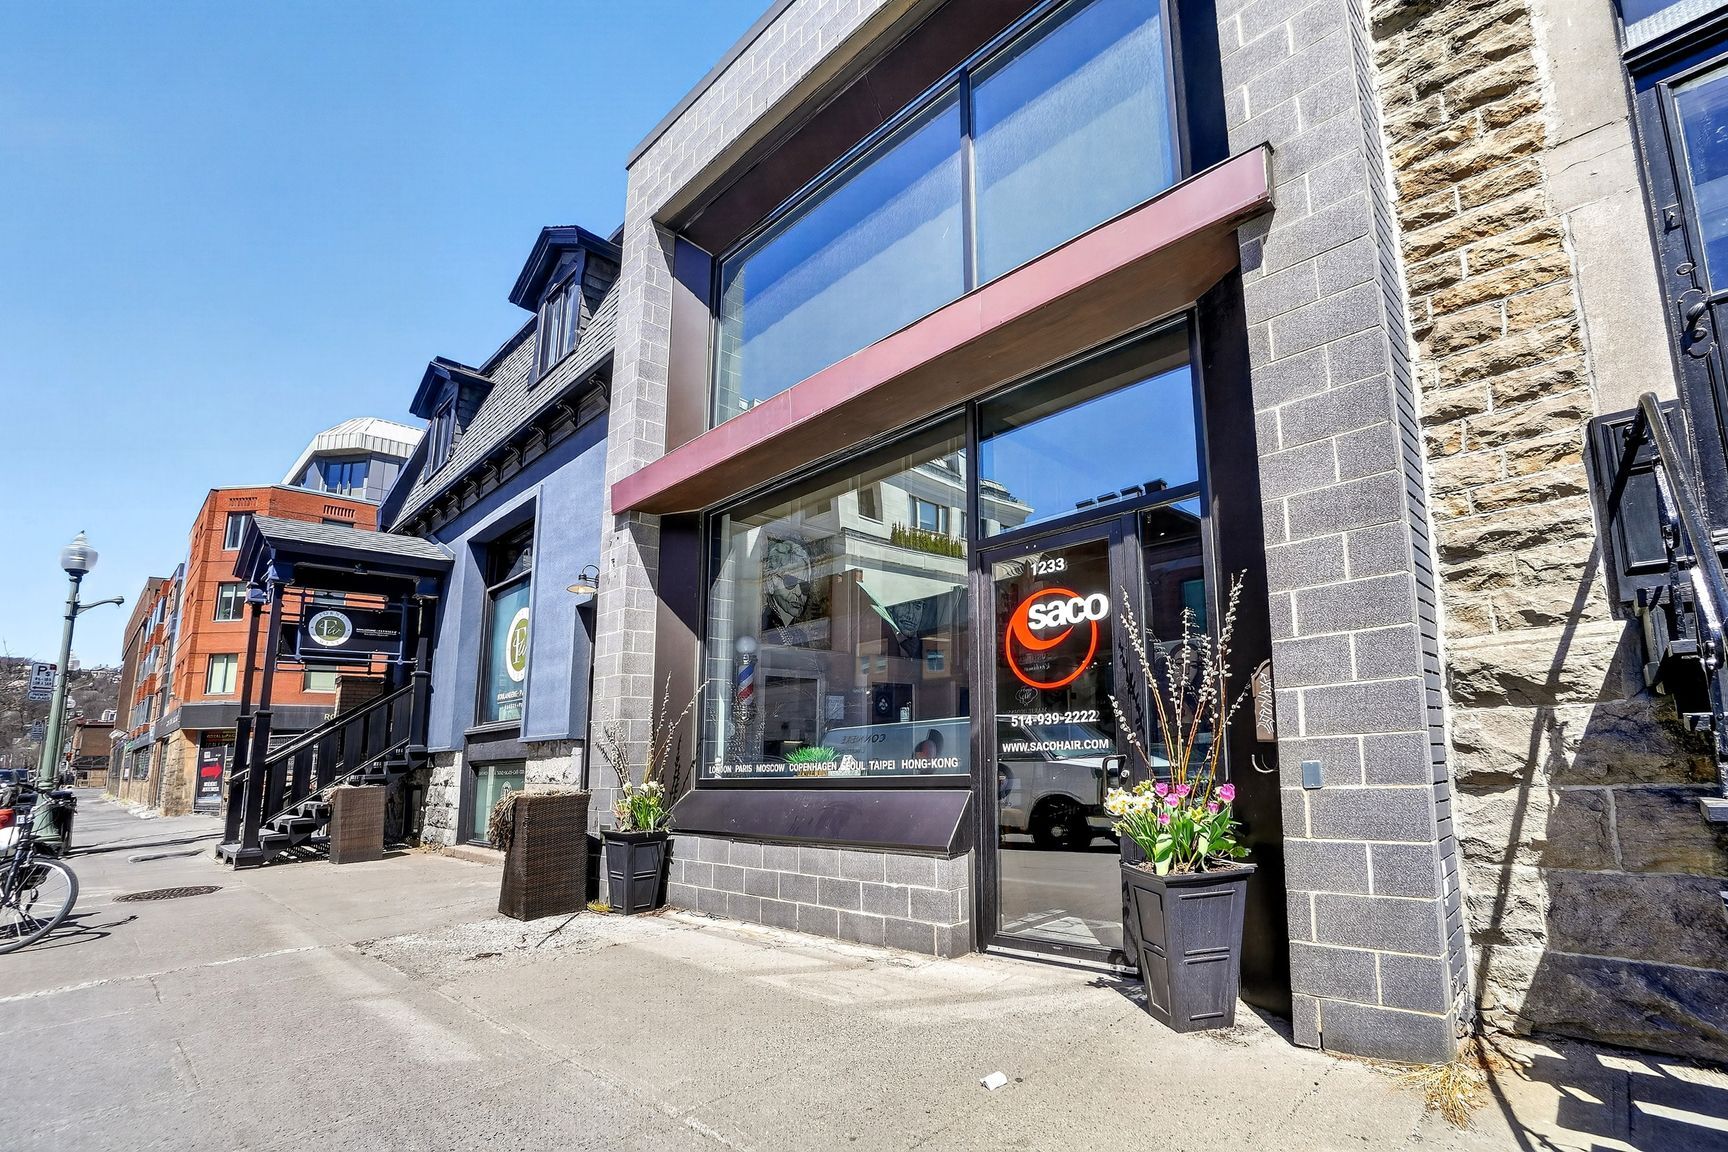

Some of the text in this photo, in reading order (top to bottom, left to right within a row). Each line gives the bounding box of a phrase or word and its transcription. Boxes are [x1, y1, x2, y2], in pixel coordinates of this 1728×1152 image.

[1030, 557, 1065, 576] 1233
[1028, 593, 1109, 630] saco
[1011, 710, 1097, 727] 514-939-2222
[1002, 739, 1109, 752] WWW.SACOHAIR.COM
[735, 764, 752, 773] PARIS
[756, 764, 785, 773] MOSCOW
[789, 762, 836, 772] COPENHAGEN
[841, 762, 866, 770] SEOUL
[869, 760, 896, 770] TAIPEI
[901, 758, 958, 769] HONG-KONG
